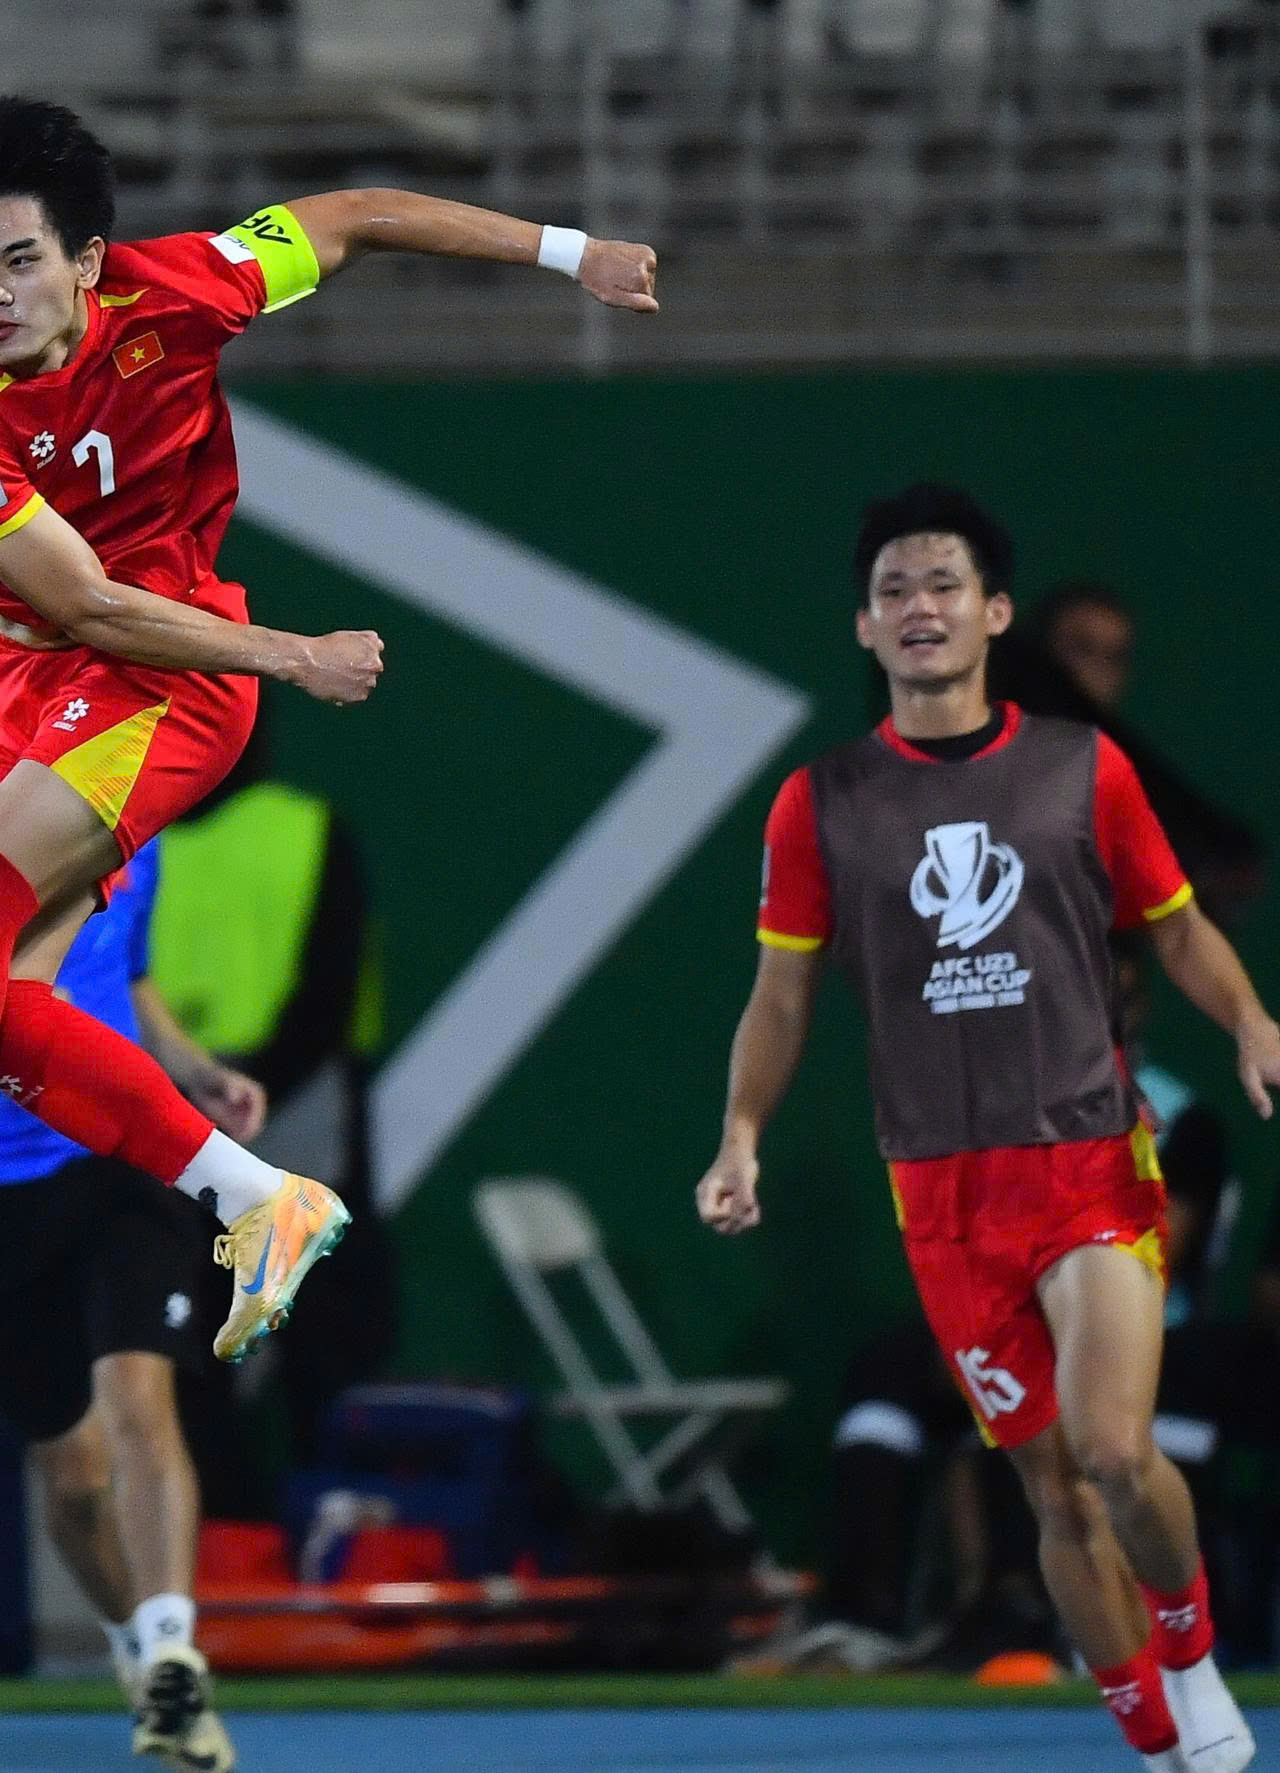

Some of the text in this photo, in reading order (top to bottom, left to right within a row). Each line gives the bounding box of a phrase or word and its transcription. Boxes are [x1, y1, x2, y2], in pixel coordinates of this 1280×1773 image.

[71, 429, 115, 498] 7
[929, 957, 974, 980] AFC
[984, 968, 1032, 993] CUP
[955, 1346, 1027, 1420] 15
